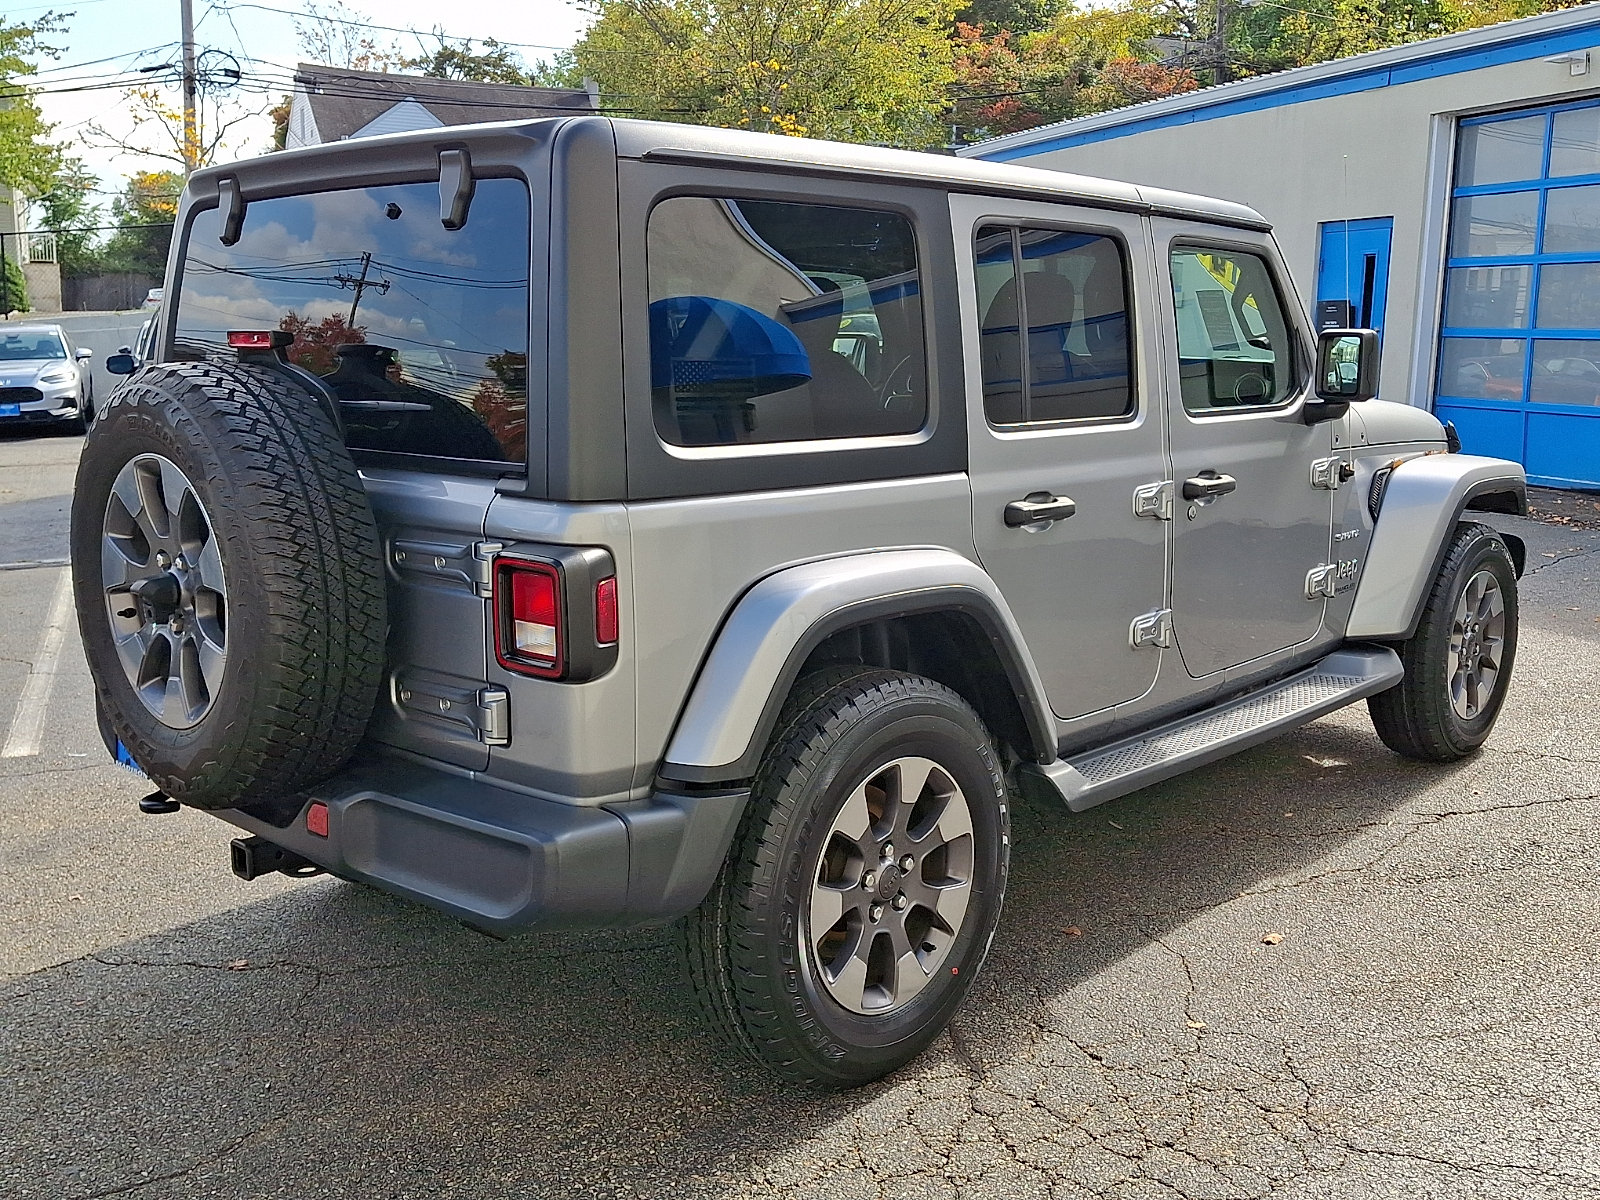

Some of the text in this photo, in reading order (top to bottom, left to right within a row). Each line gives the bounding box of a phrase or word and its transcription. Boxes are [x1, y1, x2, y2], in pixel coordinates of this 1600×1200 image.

[1336, 558, 1358, 580] Jeep
[115, 759, 149, 779] MADISON
[779, 793, 848, 1062] BRIDGESTONE
